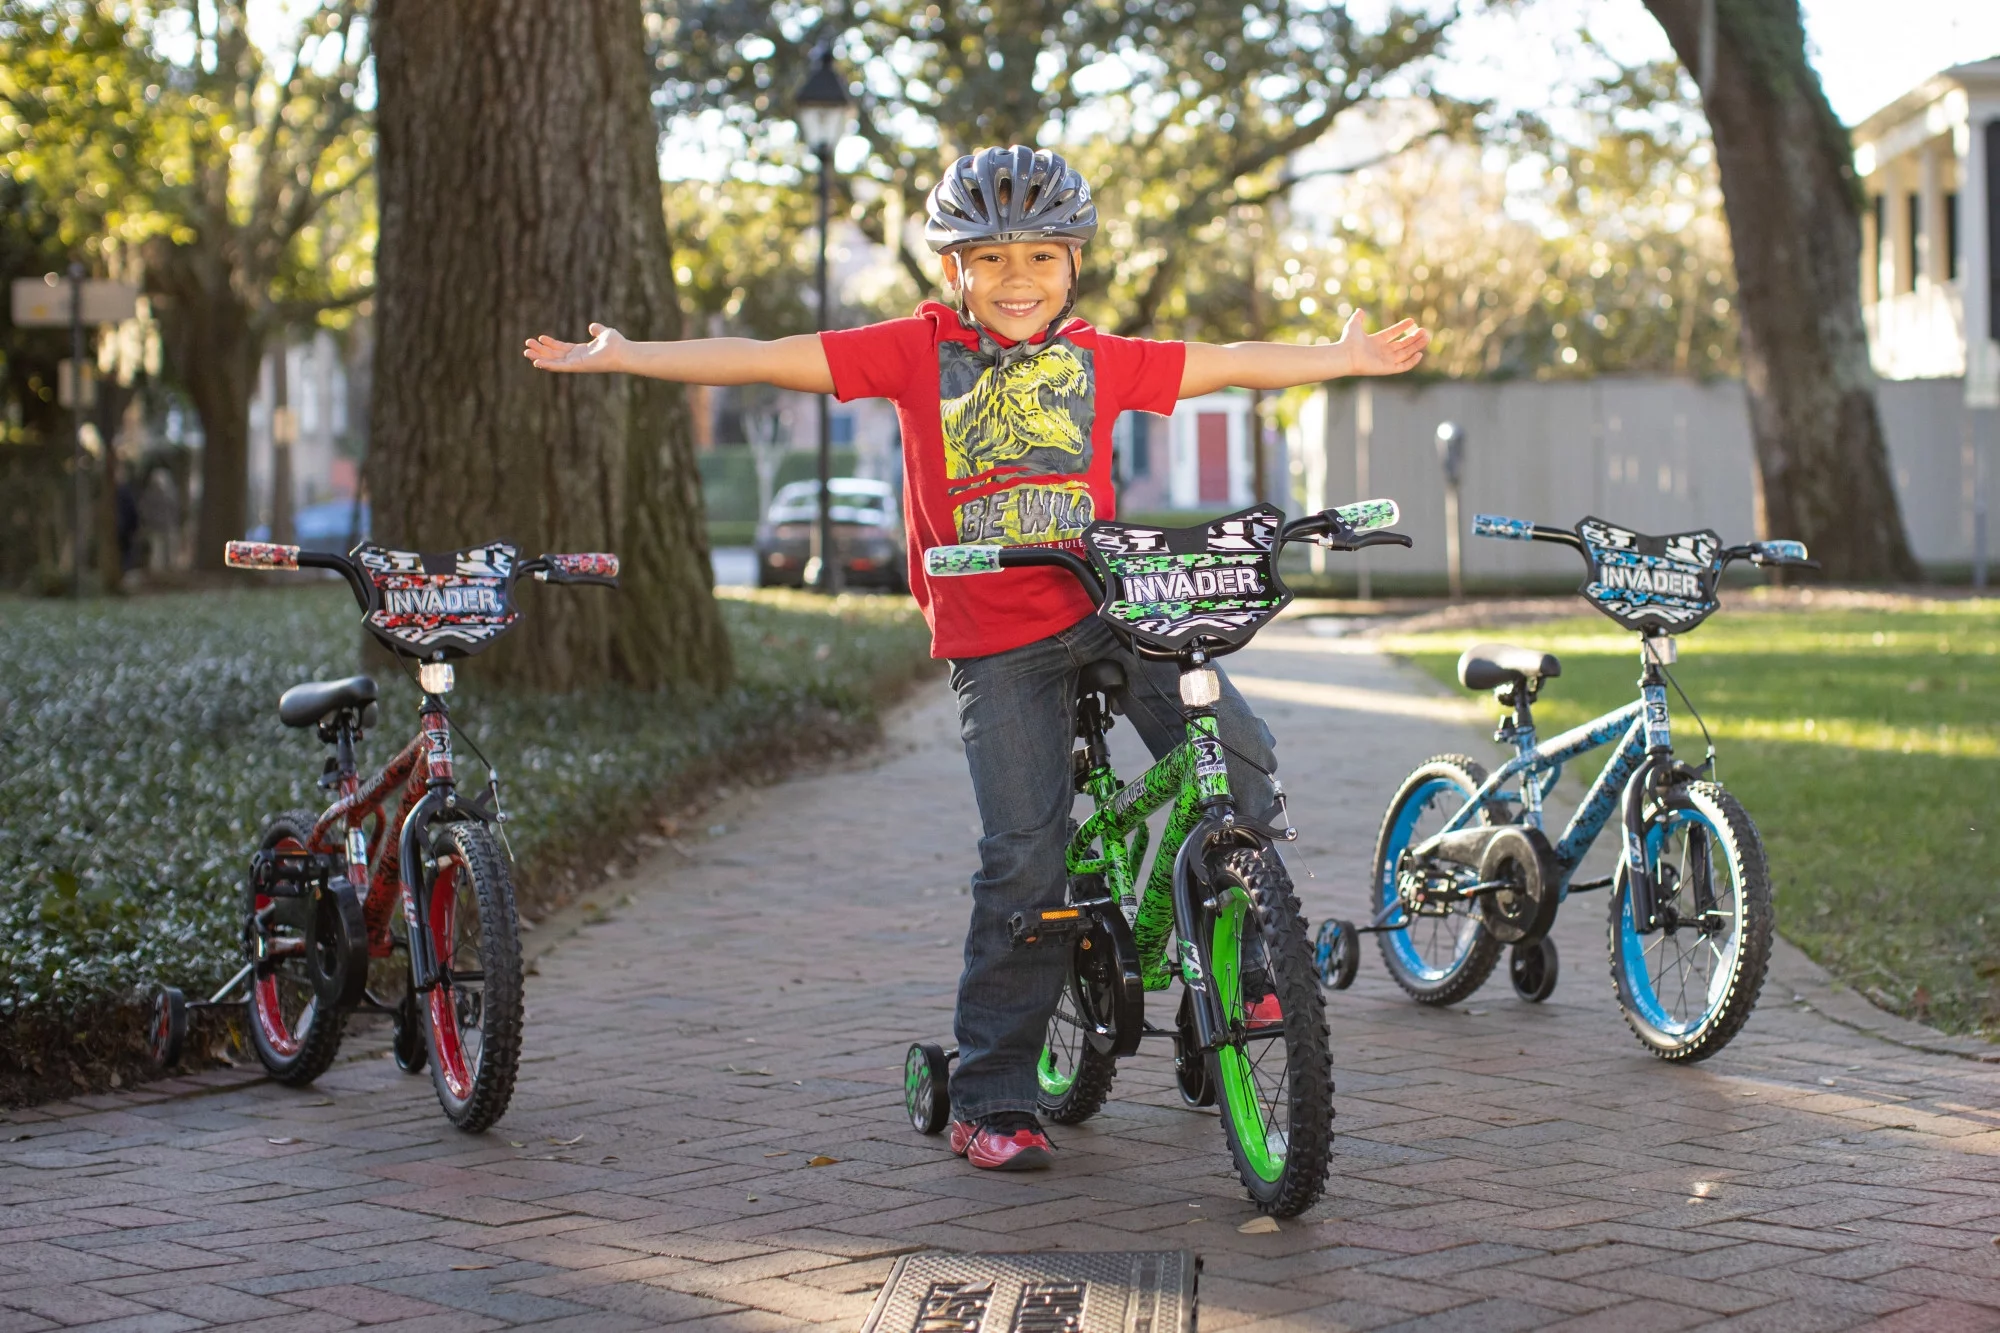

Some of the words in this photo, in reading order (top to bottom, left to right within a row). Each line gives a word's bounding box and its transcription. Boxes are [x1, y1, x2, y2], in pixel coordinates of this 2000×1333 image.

[962, 492, 1010, 543] BE
[1058, 538, 1086, 551] RULE
[1124, 567, 1261, 604] INVADER
[1601, 565, 1699, 598] INVADER
[385, 588, 498, 615] INVADER
